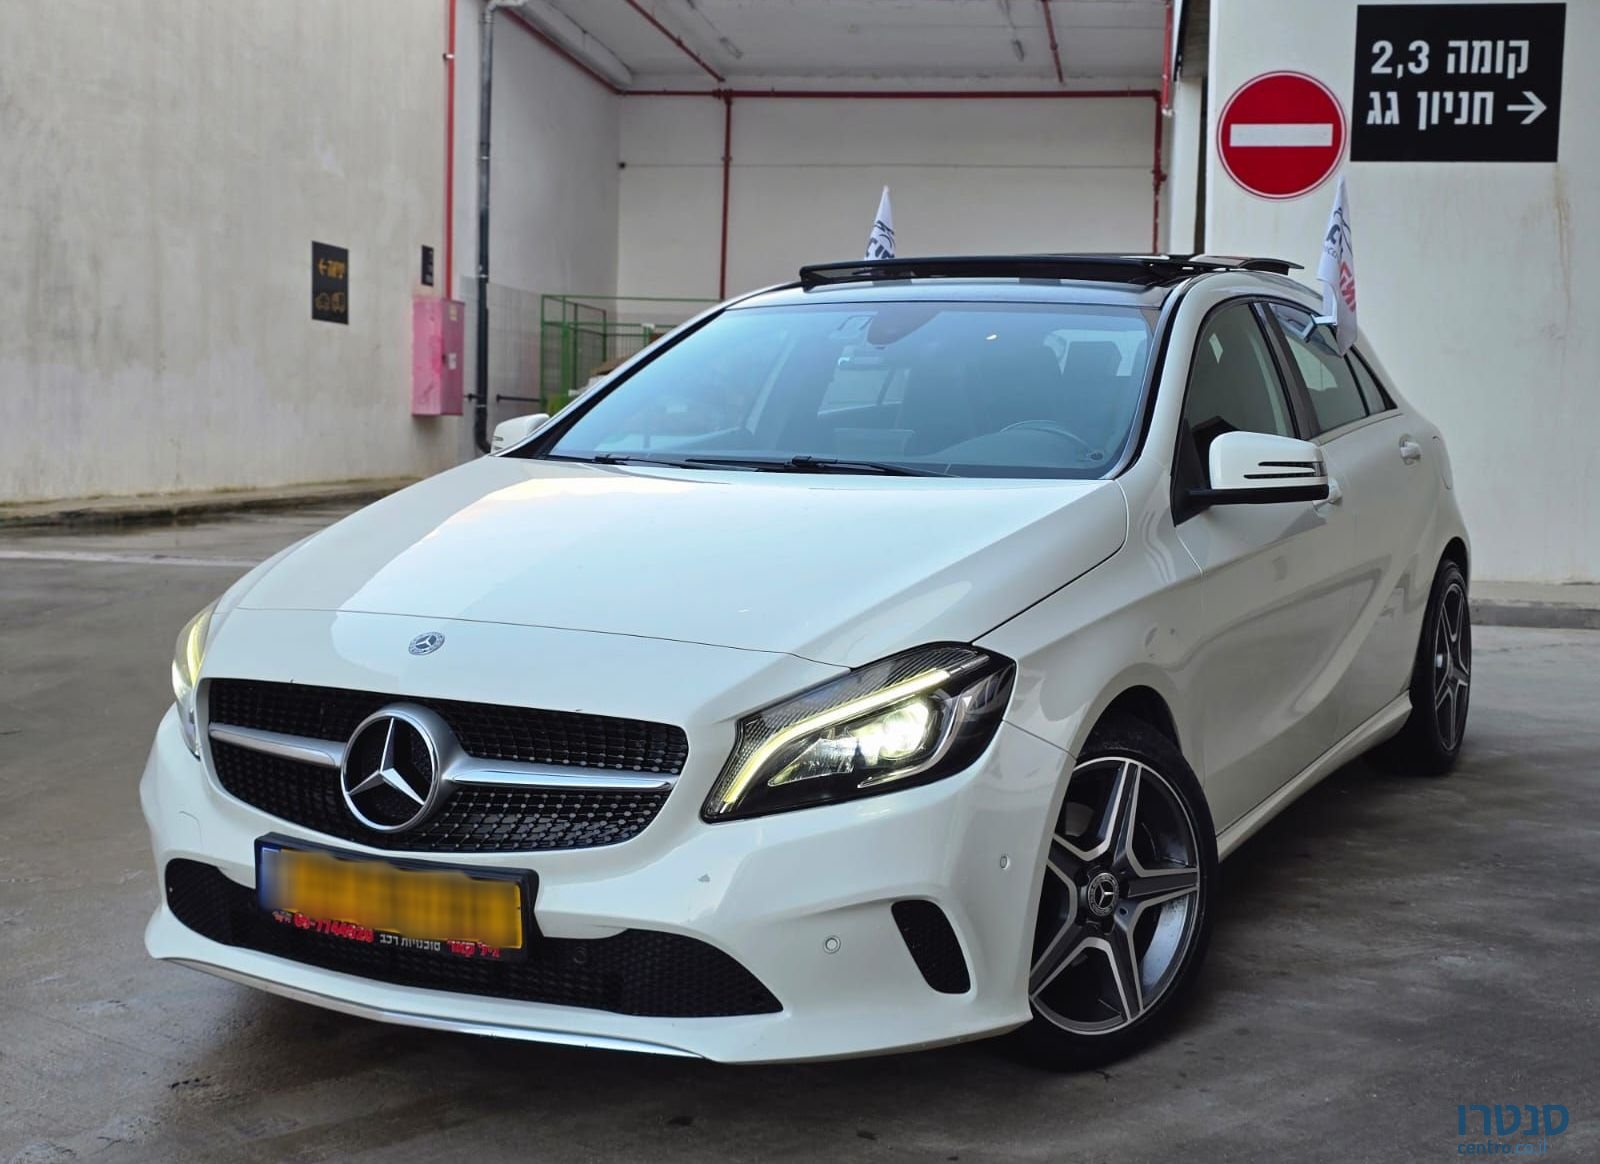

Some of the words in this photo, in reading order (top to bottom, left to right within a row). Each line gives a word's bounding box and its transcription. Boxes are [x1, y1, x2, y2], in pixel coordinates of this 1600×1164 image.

[1370, 39, 1430, 79] 2,3
[1446, 39, 1530, 79] קומה
[1366, 90, 1400, 125] גג
[1416, 90, 1495, 131] חניון
